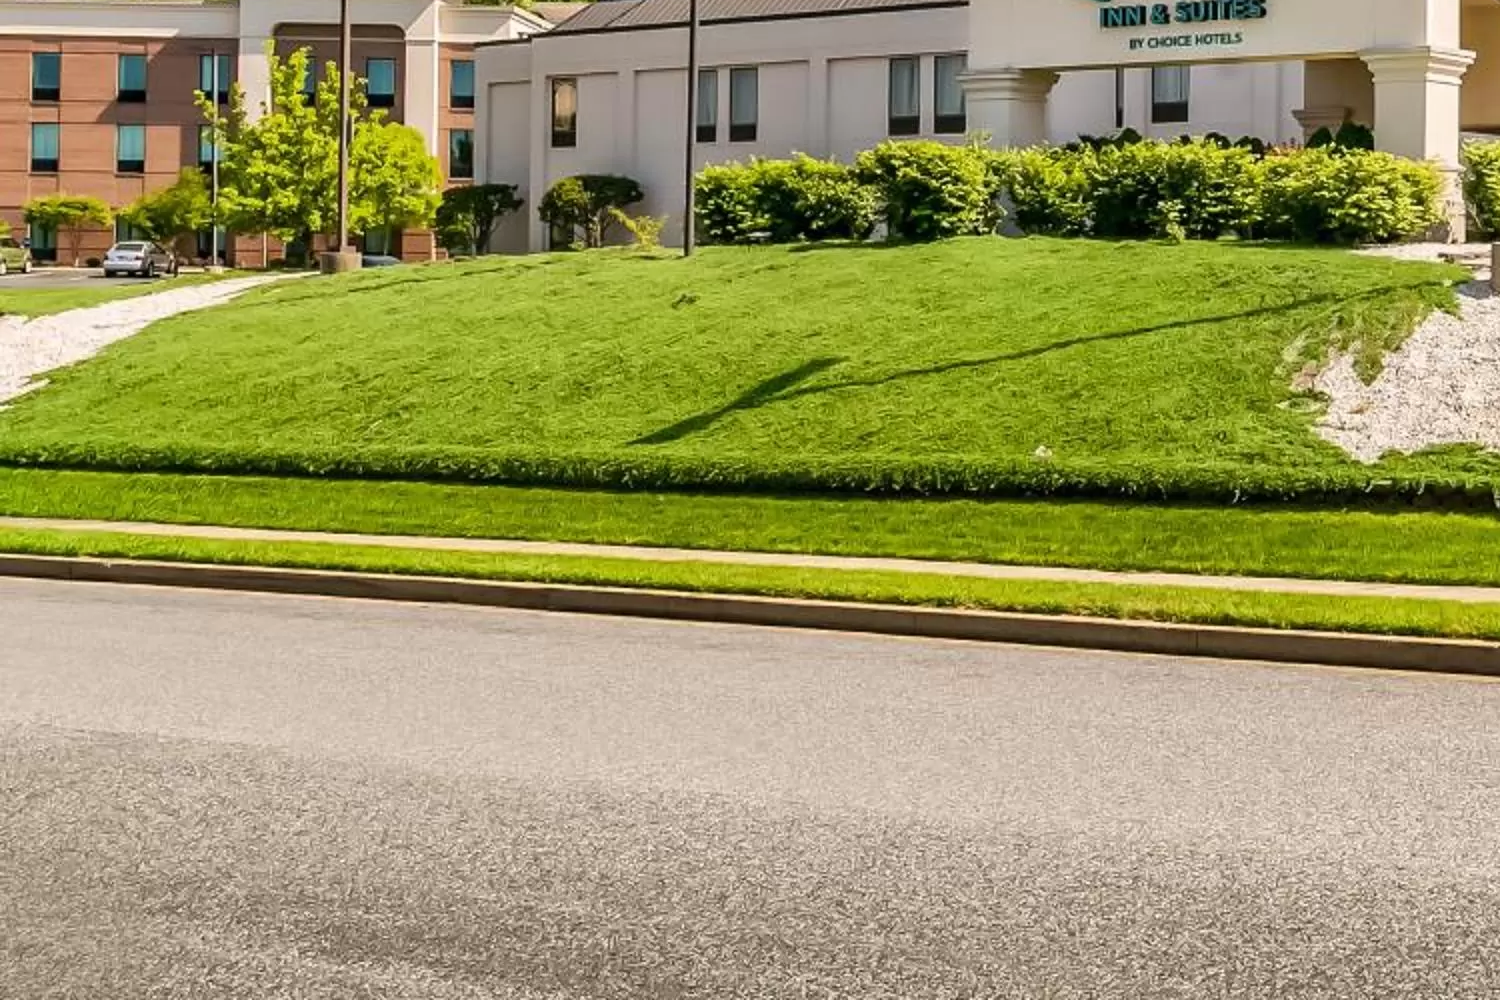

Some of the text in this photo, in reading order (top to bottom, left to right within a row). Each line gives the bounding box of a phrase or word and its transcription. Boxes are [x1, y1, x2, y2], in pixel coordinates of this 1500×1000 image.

[1100, 5, 1147, 28] INN
[1151, 3, 1171, 24] &
[1129, 32, 1243, 50] BY CHOICE HOTELS
